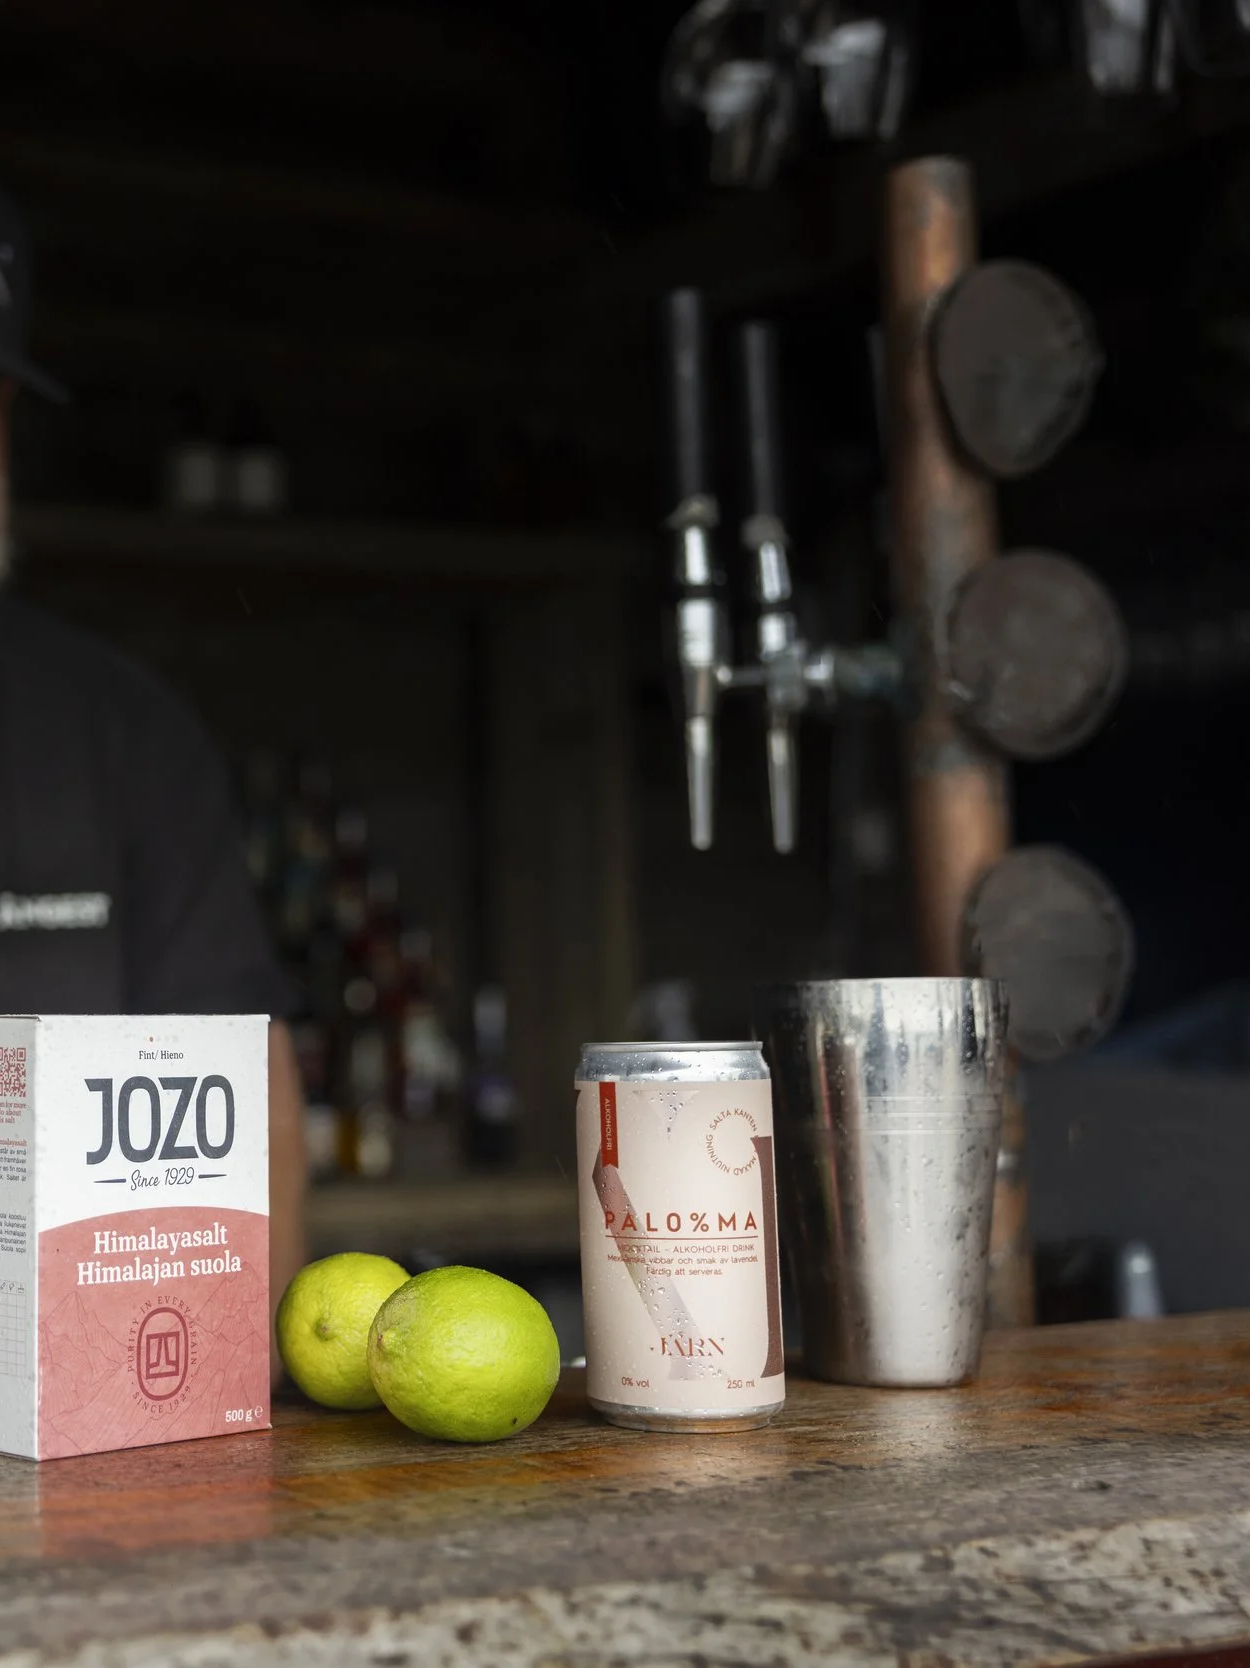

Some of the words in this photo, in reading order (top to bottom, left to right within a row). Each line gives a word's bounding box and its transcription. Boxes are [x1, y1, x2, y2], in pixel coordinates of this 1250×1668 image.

[138, 1050, 159, 1060] Fint/
[160, 1050, 184, 1060] Hieno
[84, 1074, 235, 1165] JOZO
[604, 1098, 613, 1151] ALKOHOLFRI
[710, 1109, 731, 1130] SALTA
[734, 1108, 758, 1132] KANTEN
[706, 1134, 730, 1173] NJUTNING
[130, 1169, 160, 1191] Since
[164, 1167, 195, 1186] 1929
[605, 1211, 758, 1232] PALO%MA
[93, 1222, 228, 1255] Himalayasalt
[673, 1245, 729, 1254] ALKOHOLFRI
[732, 1244, 755, 1253] DRINK
[77, 1256, 185, 1286] Himalajan
[190, 1250, 242, 1276] suola
[649, 1255, 674, 1264] vibbar
[696, 1256, 716, 1264] smak
[674, 1268, 685, 1276] att
[140, 1300, 152, 1314] IN
[157, 1295, 191, 1315] EVERY
[127, 1319, 139, 1373] PURITY
[621, 1377, 634, 1387] 0%
[637, 1380, 650, 1388] vol
[727, 1380, 743, 1389] 250
[746, 1380, 755, 1388] ml
[132, 1391, 164, 1414] SINCE
[169, 1385, 191, 1411] 1929
[225, 1409, 244, 1422] 500
[245, 1408, 253, 1422] g
